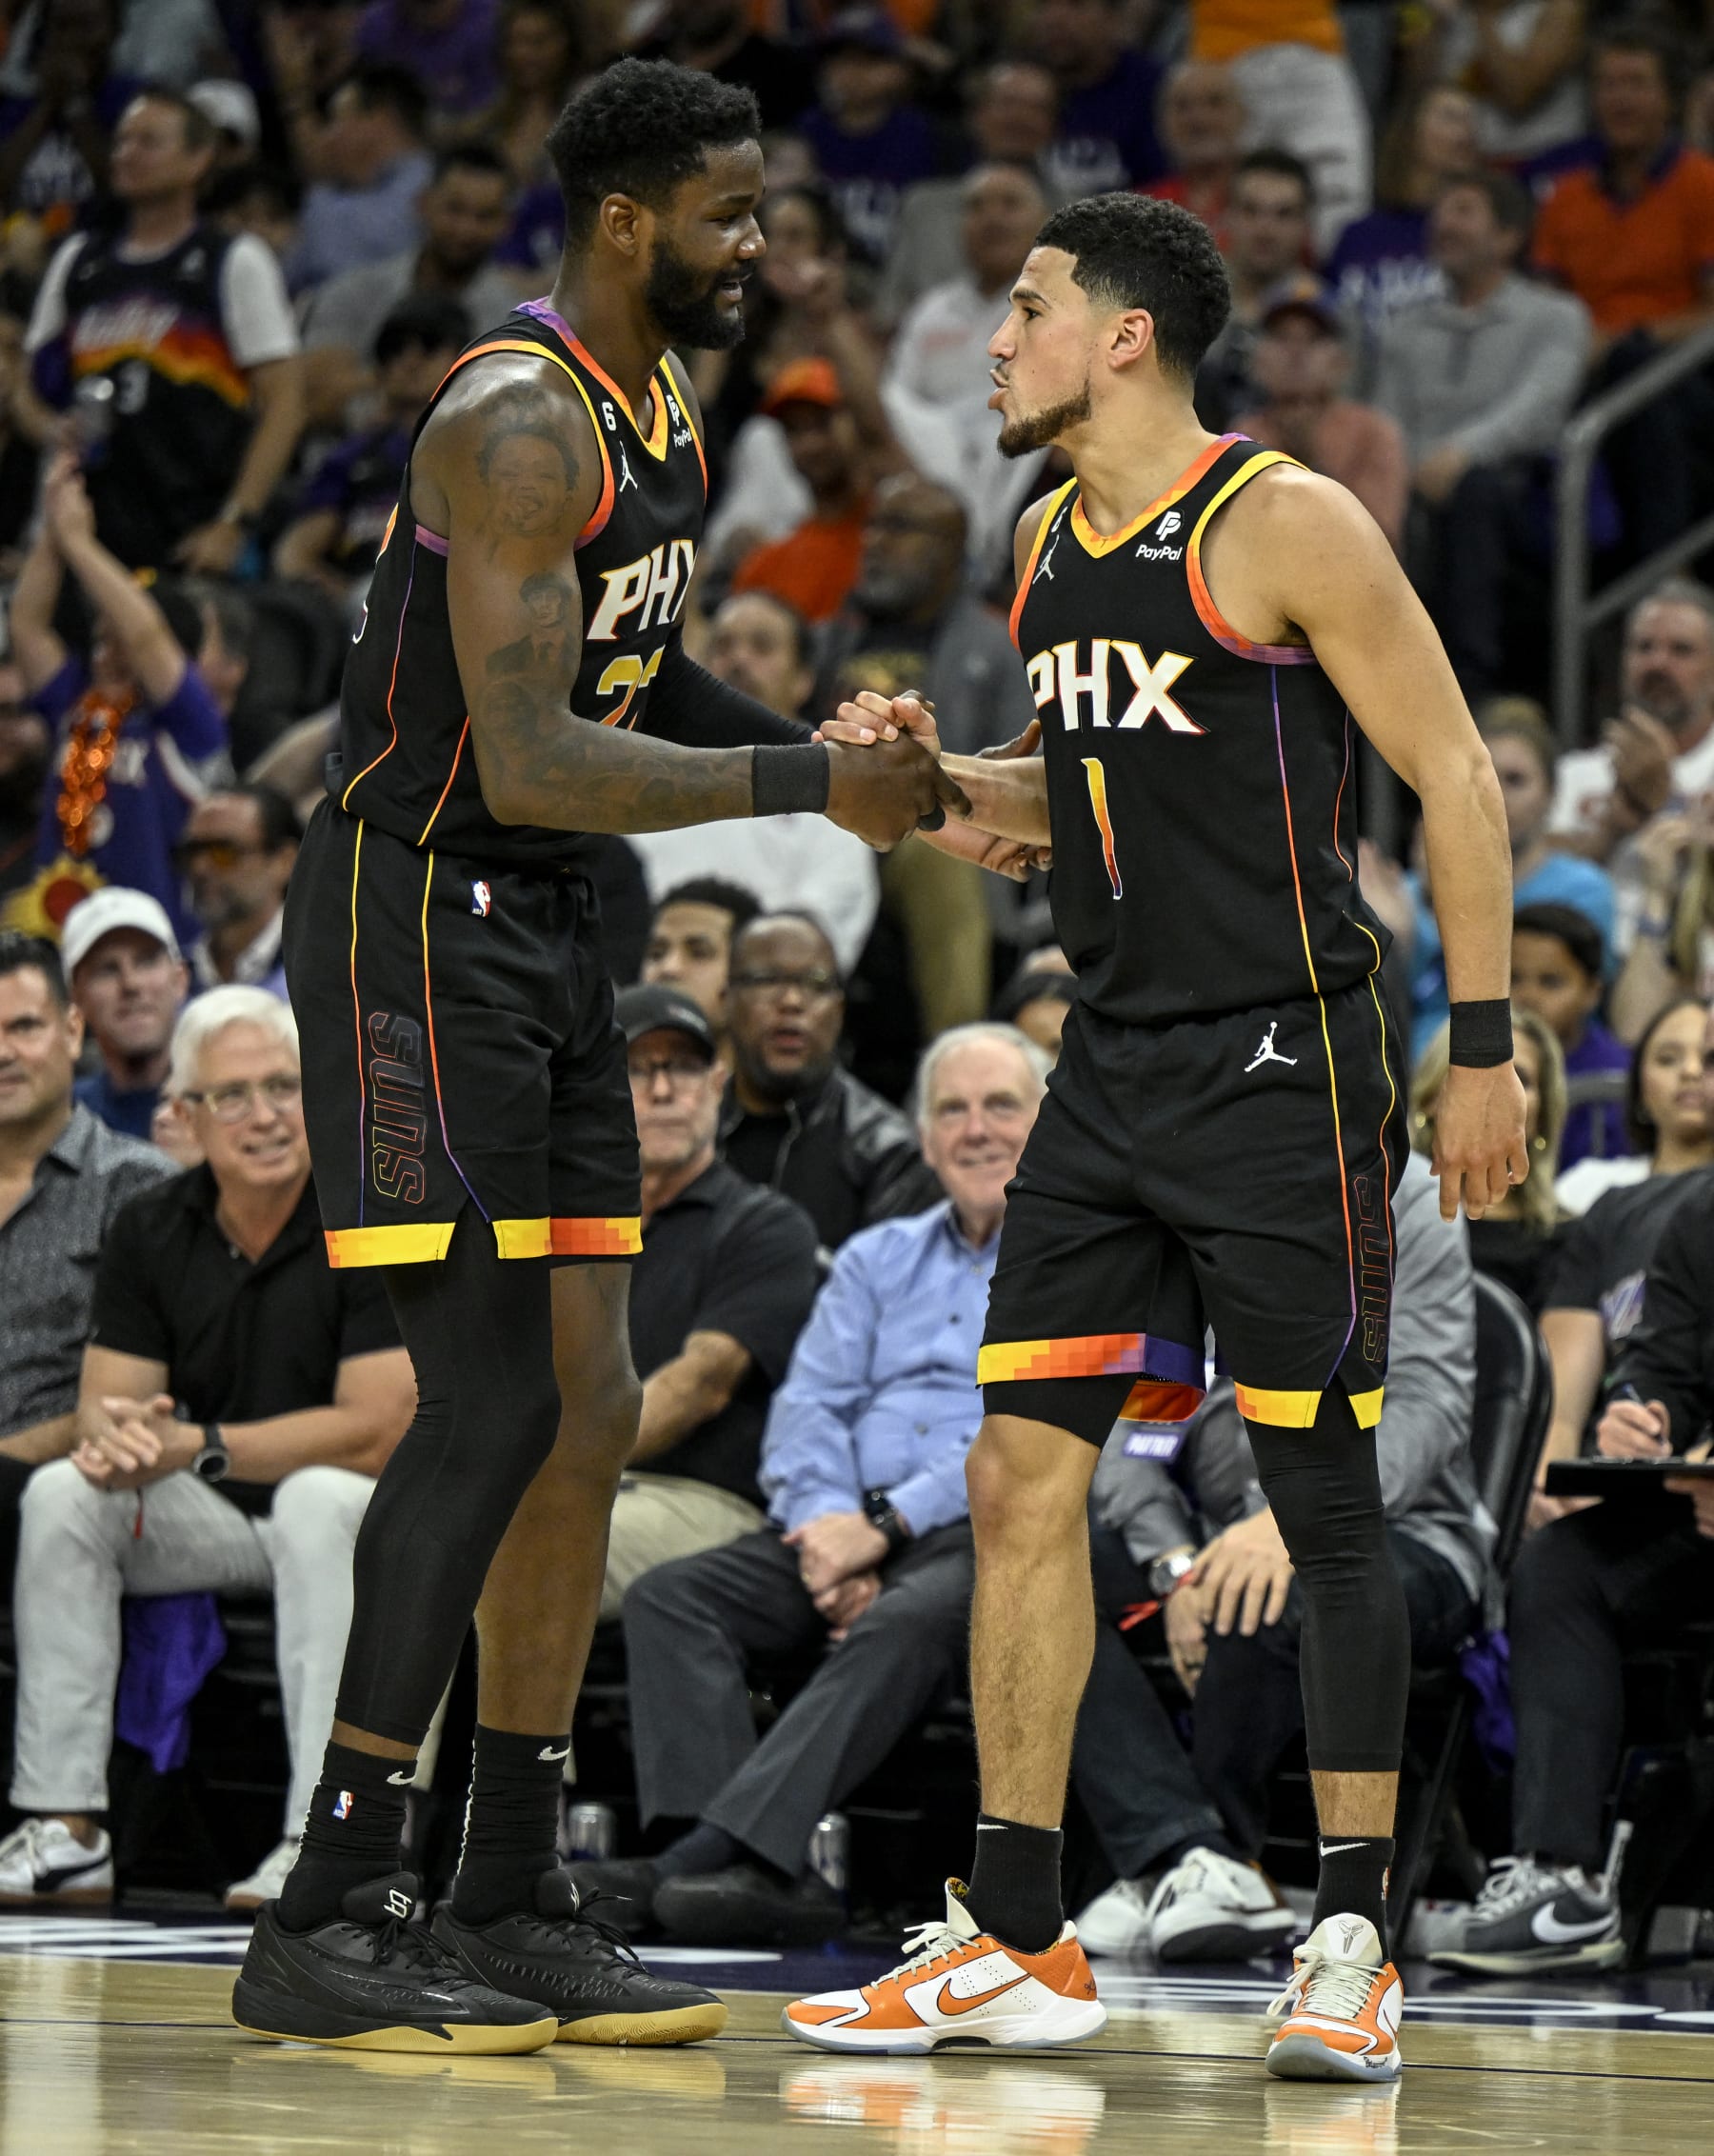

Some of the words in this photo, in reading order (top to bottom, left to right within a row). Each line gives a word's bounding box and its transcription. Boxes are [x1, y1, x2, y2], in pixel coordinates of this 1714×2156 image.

[602, 402, 617, 430] 6
[1135, 544, 1184, 562] PayPal
[1026, 639, 1206, 735] PHX
[1081, 758, 1123, 900] 1
[368, 1011, 428, 1205] SUNS
